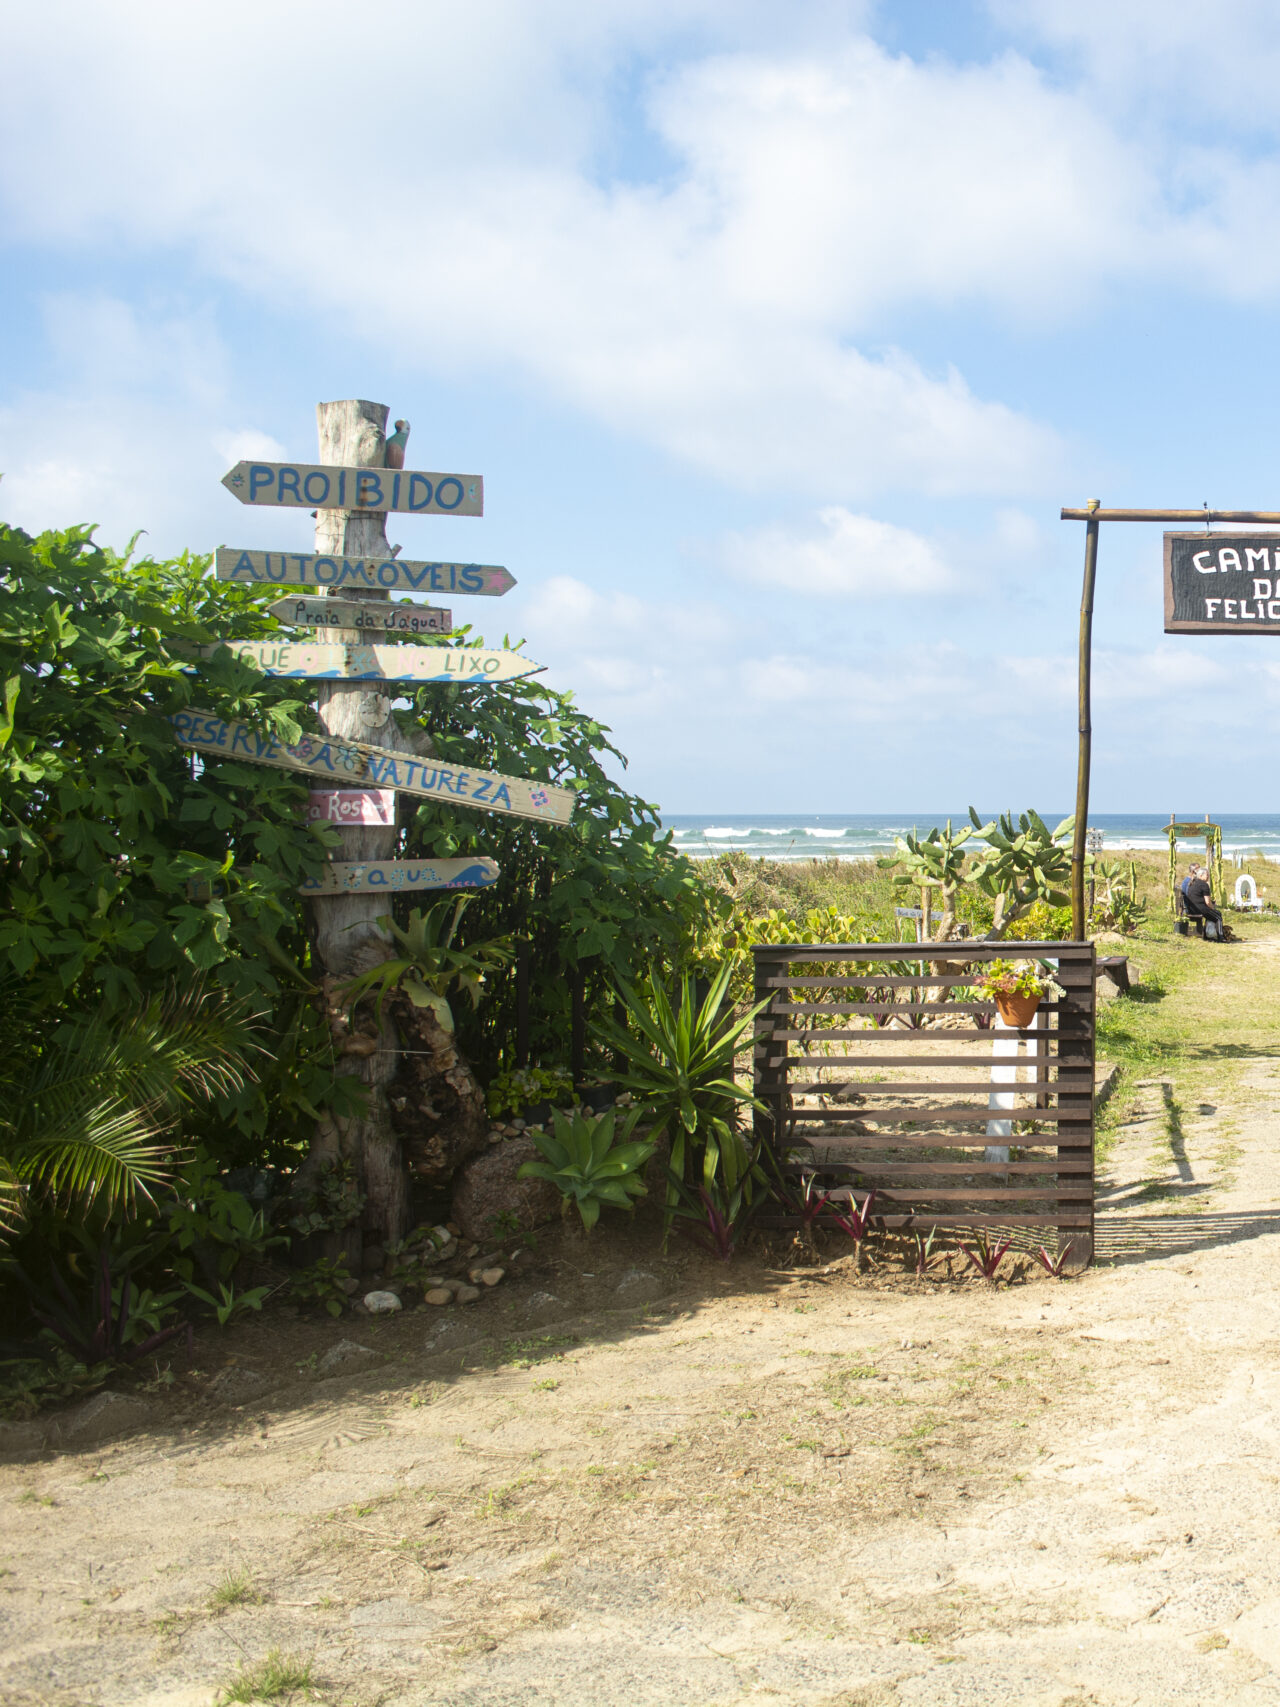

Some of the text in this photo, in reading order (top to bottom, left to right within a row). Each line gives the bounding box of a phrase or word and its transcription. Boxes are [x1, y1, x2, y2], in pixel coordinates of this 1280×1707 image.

[249, 465, 465, 511] PROIBIDO
[230, 551, 485, 593] AUTOMÓVEIS
[295, 601, 445, 633] Praia da Jagua!
[299, 649, 318, 669] O
[397, 651, 432, 674] NO
[444, 653, 501, 674] LIXO
[307, 743, 335, 771] A
[363, 754, 512, 811] NATUREZA
[327, 792, 374, 821] Rosa
